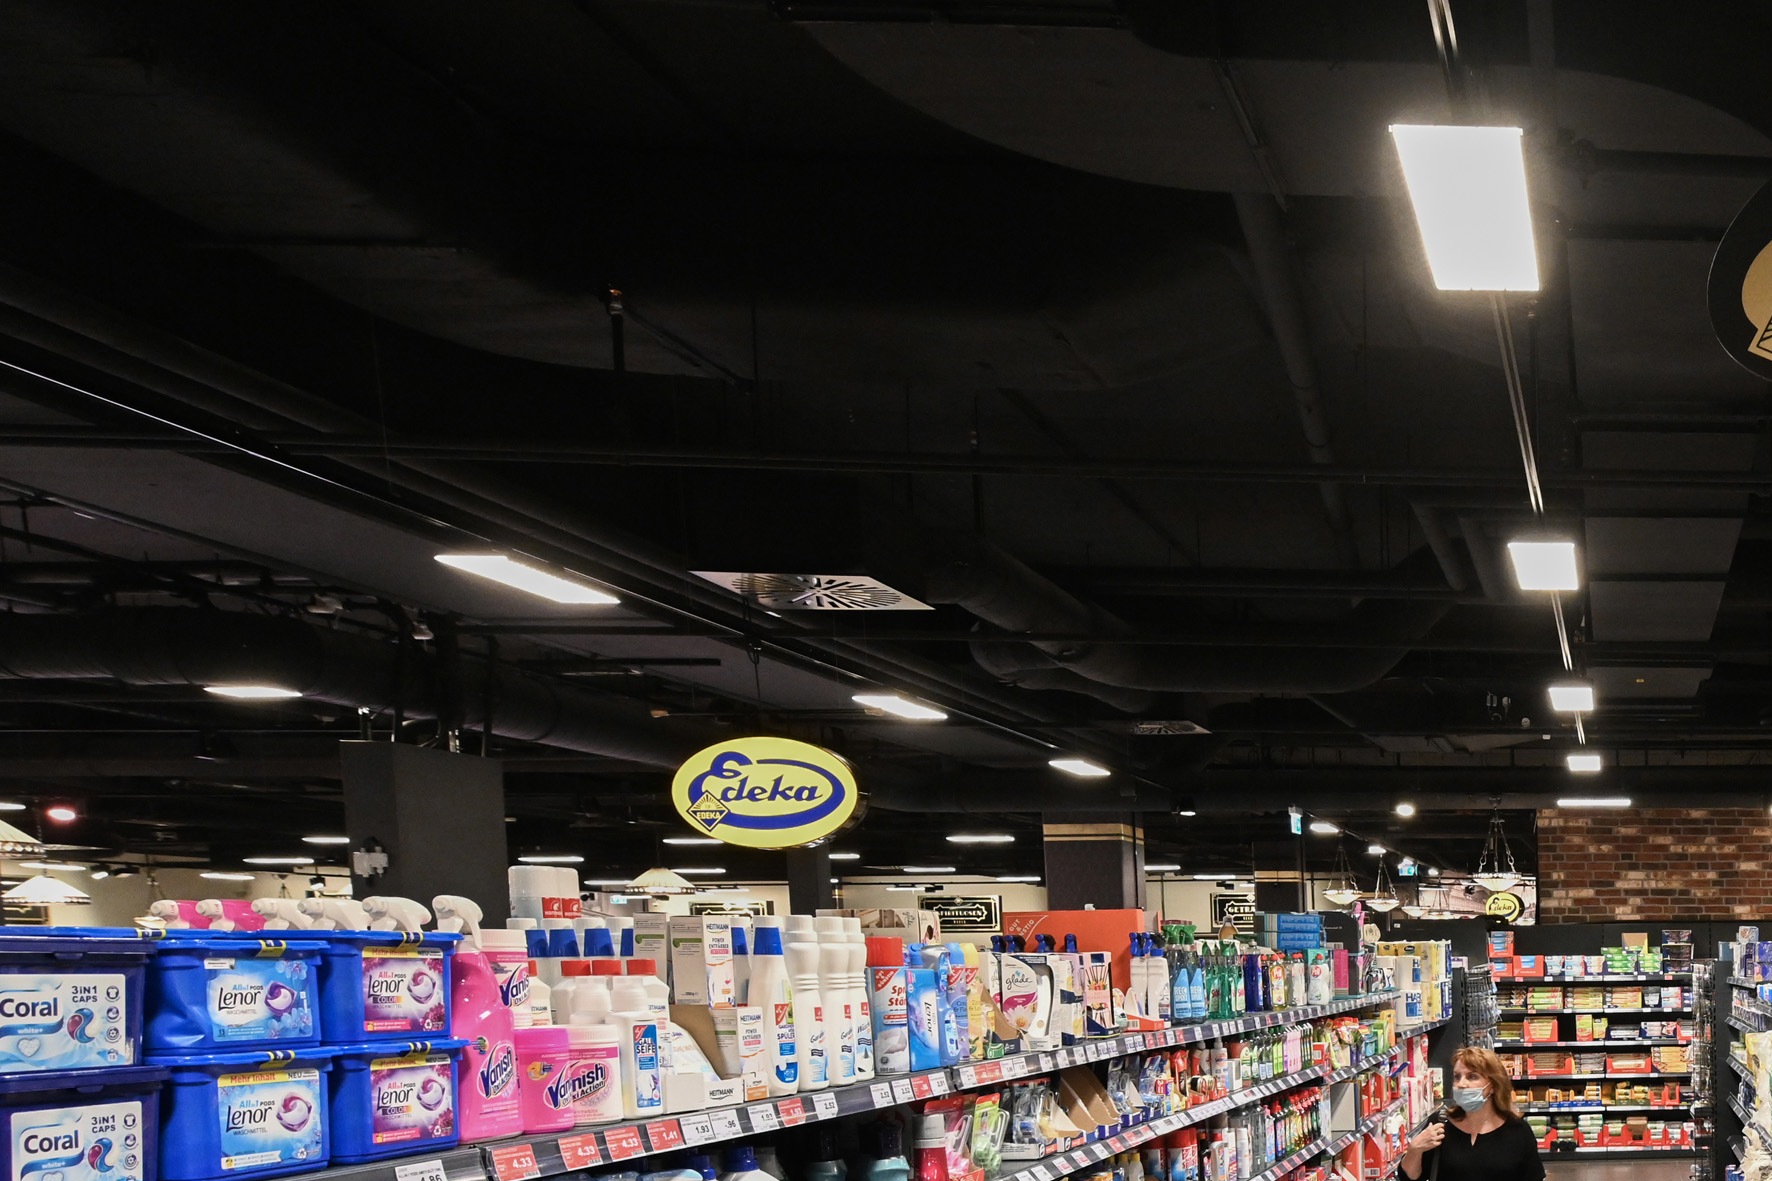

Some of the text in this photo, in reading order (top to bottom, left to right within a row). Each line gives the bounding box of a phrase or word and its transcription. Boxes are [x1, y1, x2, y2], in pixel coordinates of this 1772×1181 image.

[688, 751, 823, 801] Edeka
[696, 810, 721, 820] EDEKA
[706, 923, 729, 932] HEITMANN
[368, 977, 403, 998] Lenor
[72, 994, 98, 1003] CAPS
[218, 988, 262, 1012] Lenor
[0, 997, 58, 1018] Coral
[636, 1044, 656, 1054] SEIFE
[230, 1073, 276, 1083] Mehr Inhalt
[377, 1087, 413, 1111] Lenor
[709, 1087, 734, 1099] HEITMANN
[226, 1106, 273, 1134] Lenor
[92, 1124, 116, 1133] CAPS
[695, 1125, 710, 1136] 1.93
[23, 1130, 79, 1154] Coral
[621, 1137, 639, 1148] 4.33
[577, 1146, 596, 1158] 4.33
[512, 1156, 533, 1169] 4.33
